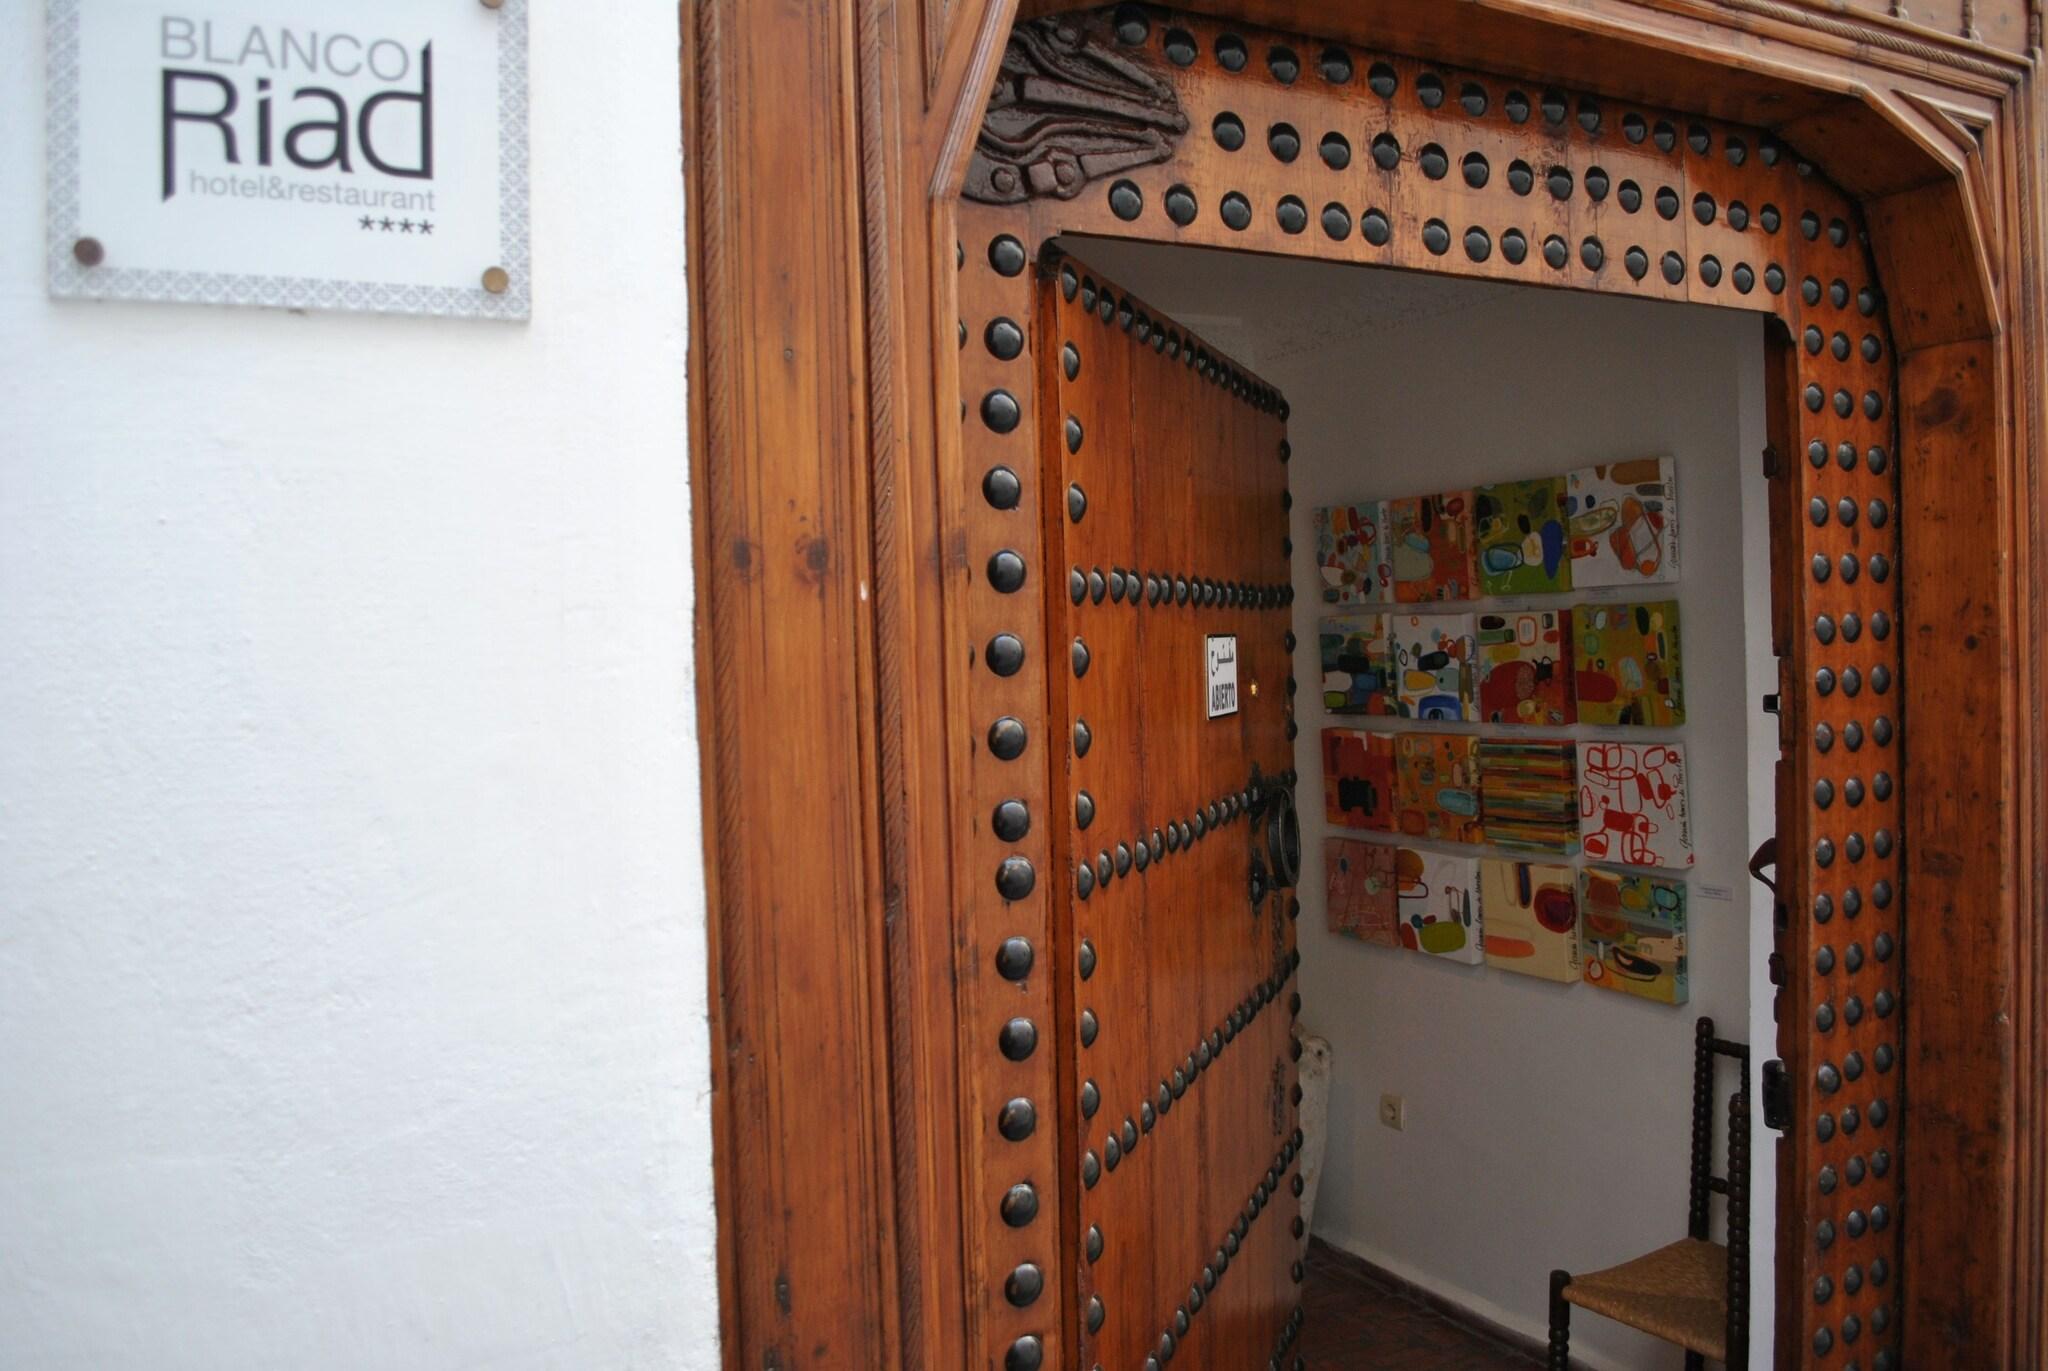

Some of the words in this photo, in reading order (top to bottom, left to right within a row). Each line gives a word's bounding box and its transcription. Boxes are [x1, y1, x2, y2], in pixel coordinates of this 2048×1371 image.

[160, 16, 410, 81] BLANCO
[161, 39, 434, 203] Riad
[189, 169, 436, 212] hotel&restaurant
[1211, 682, 1236, 712] ABIERTO
